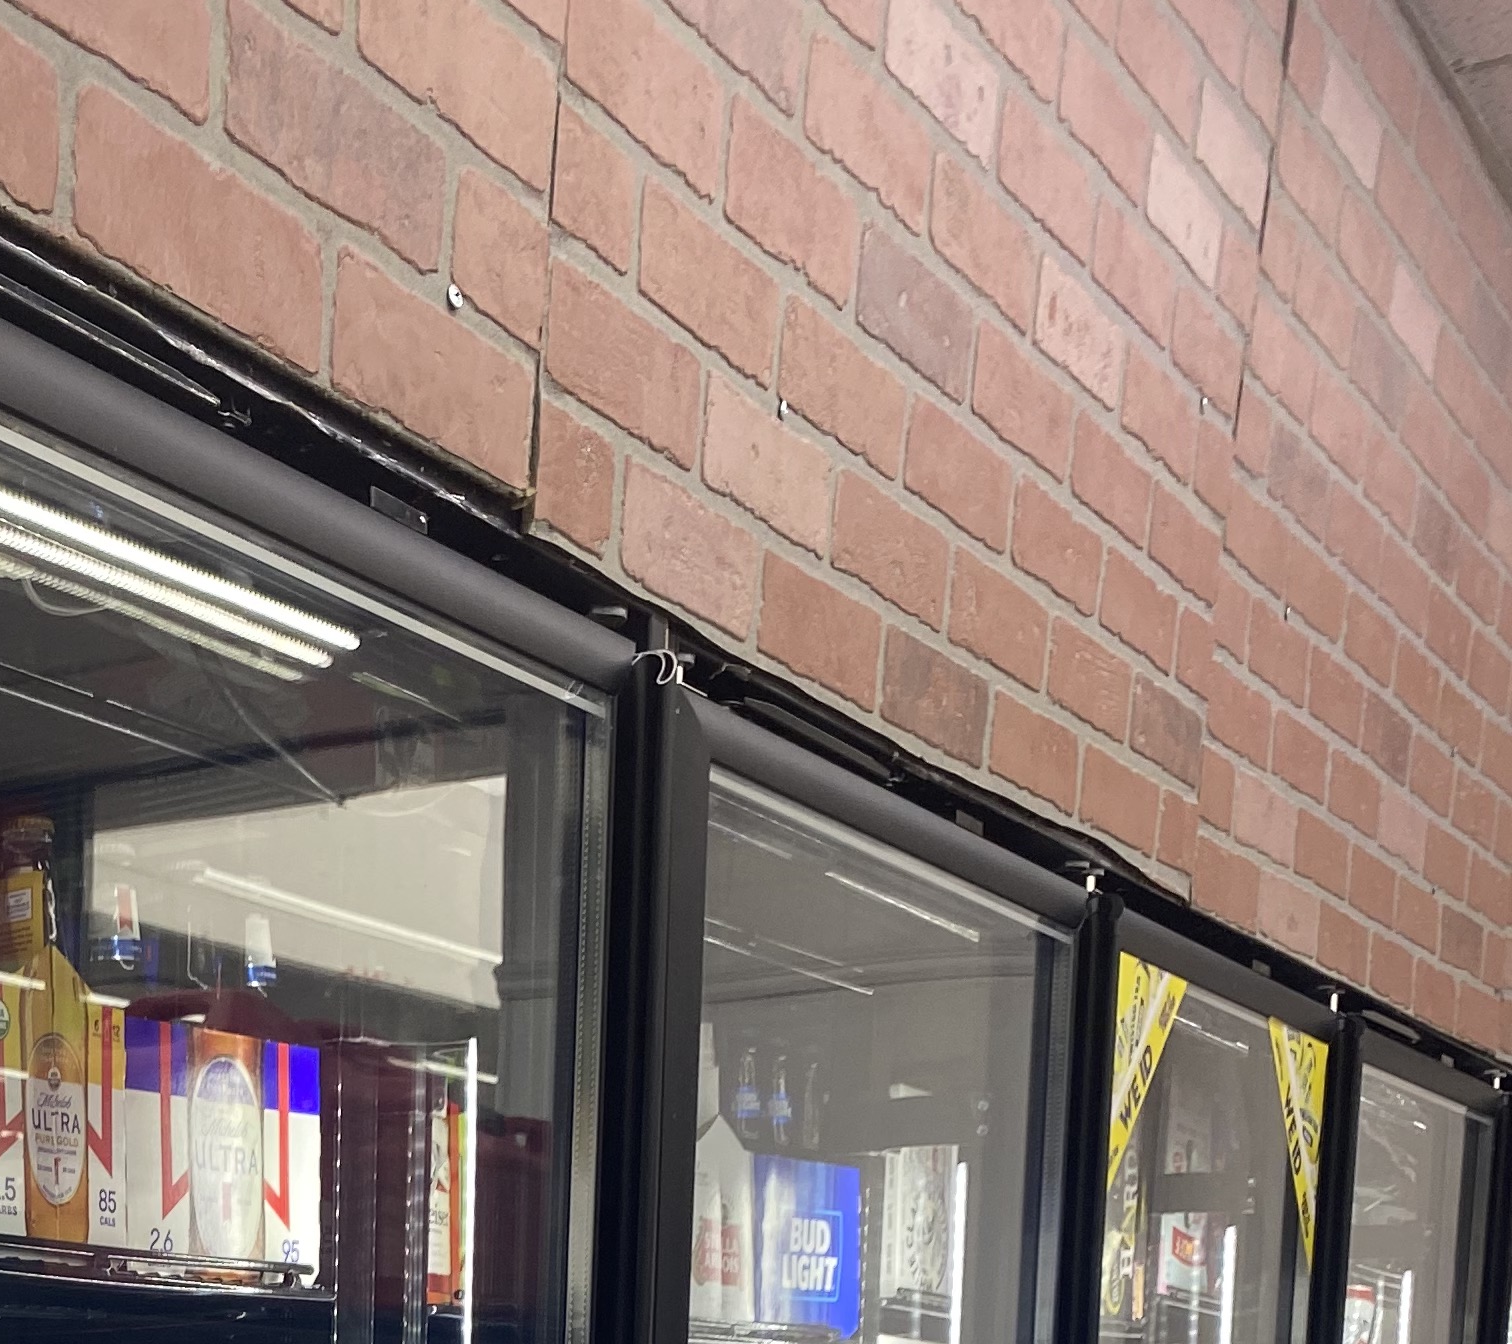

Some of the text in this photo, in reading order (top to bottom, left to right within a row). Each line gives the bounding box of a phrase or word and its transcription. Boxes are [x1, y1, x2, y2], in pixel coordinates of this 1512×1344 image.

[1119, 1044, 1153, 1130] WE ID
[31, 1108, 81, 1135] ULTRA
[56, 1135, 79, 1148] GOLD
[195, 1138, 259, 1175] ULTRA
[98, 1188, 117, 1214] 85
[99, 1216, 116, 1228] CALS
[791, 1217, 831, 1255] BUD
[282, 1239, 300, 1264] 95
[781, 1254, 838, 1293] LIGHT
